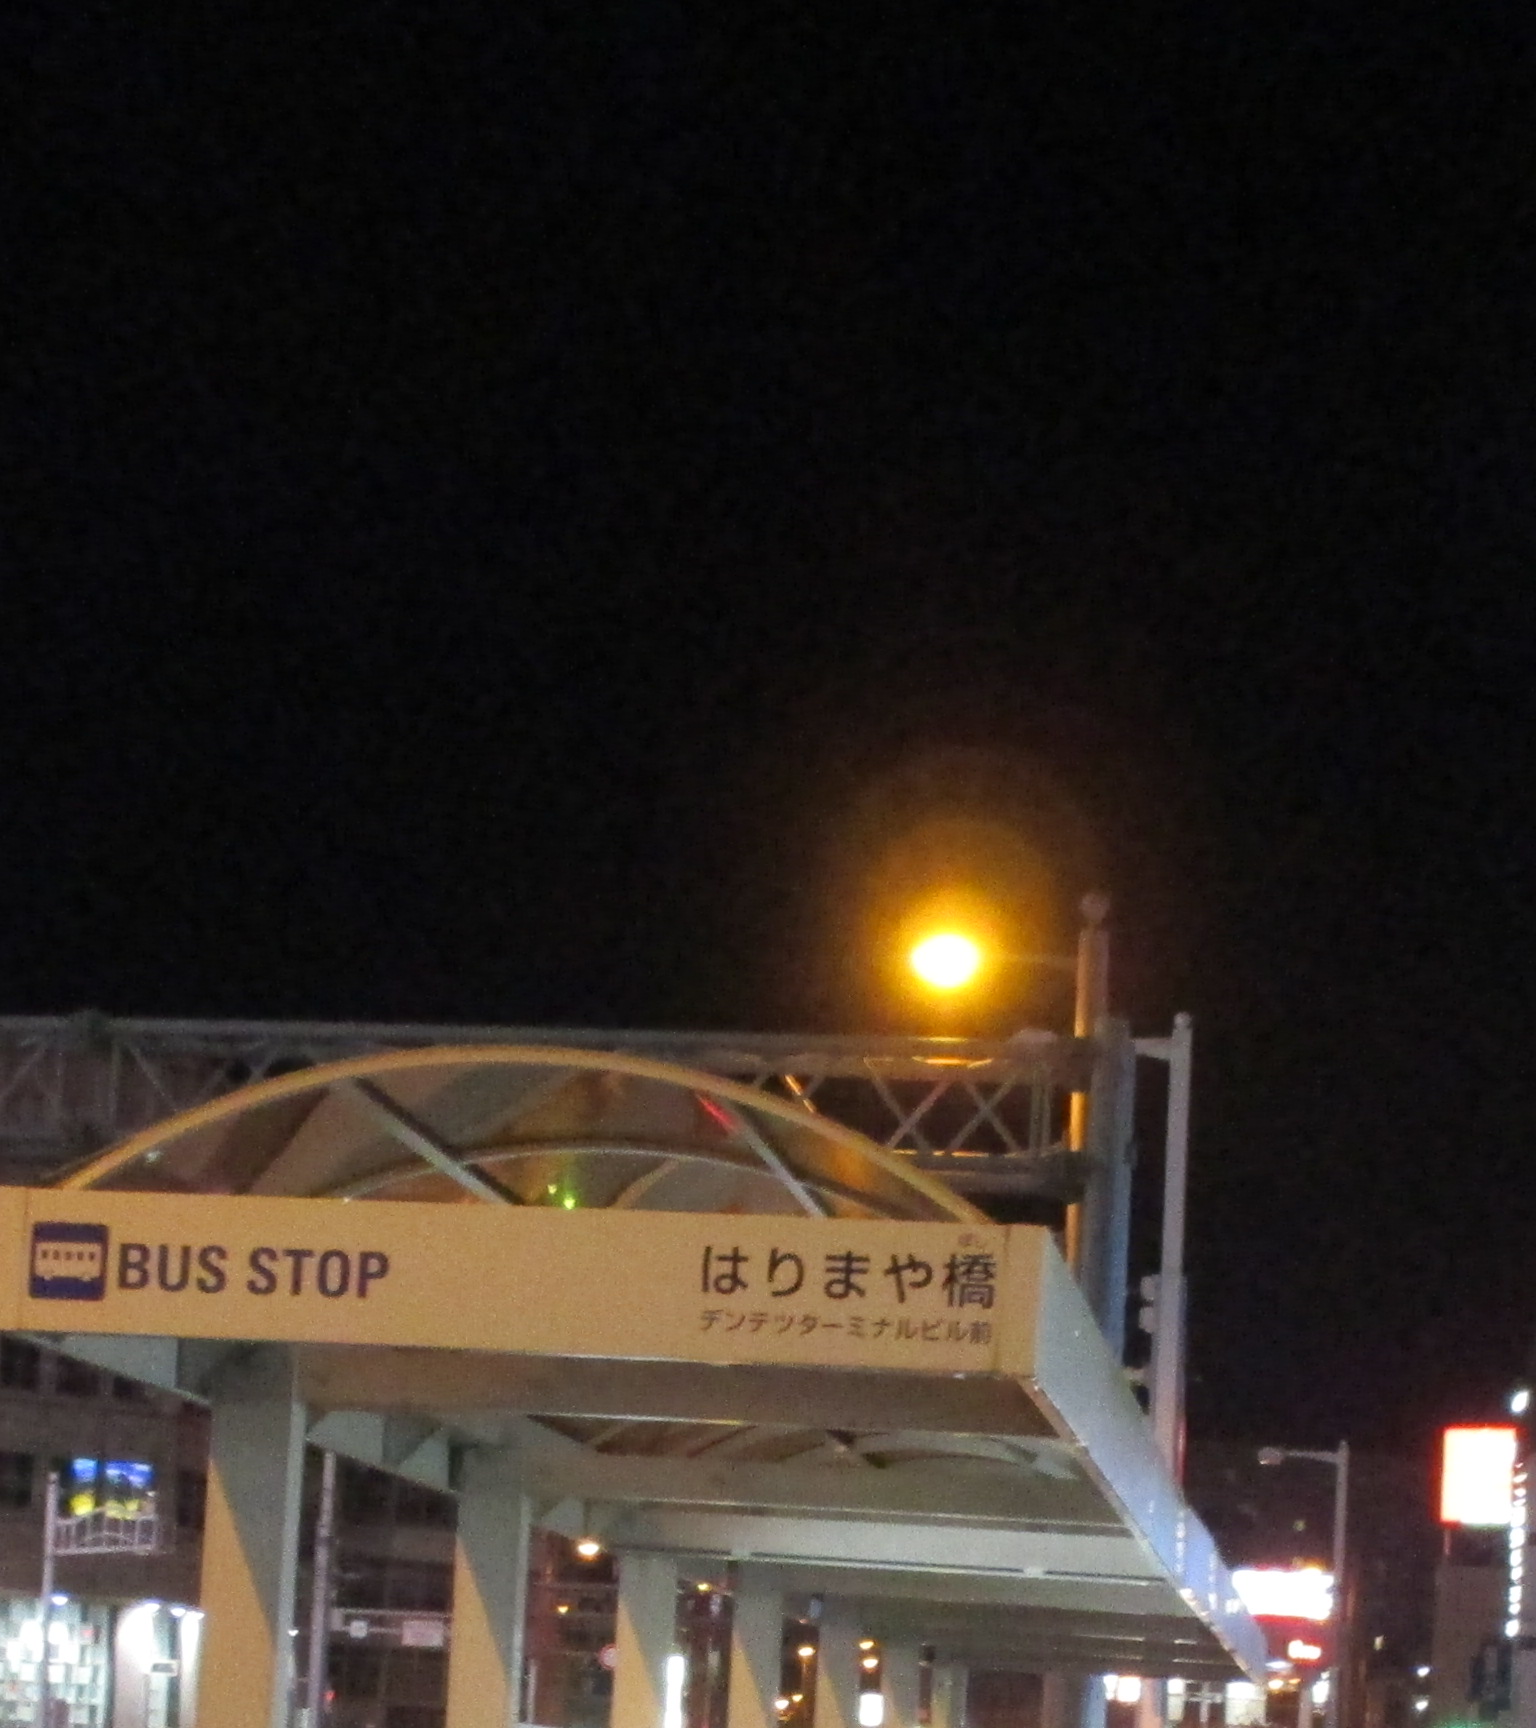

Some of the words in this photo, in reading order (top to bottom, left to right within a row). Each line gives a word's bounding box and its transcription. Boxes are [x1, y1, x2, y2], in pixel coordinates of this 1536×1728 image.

[117, 1242, 229, 1294] BUS
[246, 1247, 390, 1300] STOP
[700, 1245, 997, 1309] はりまや橋
